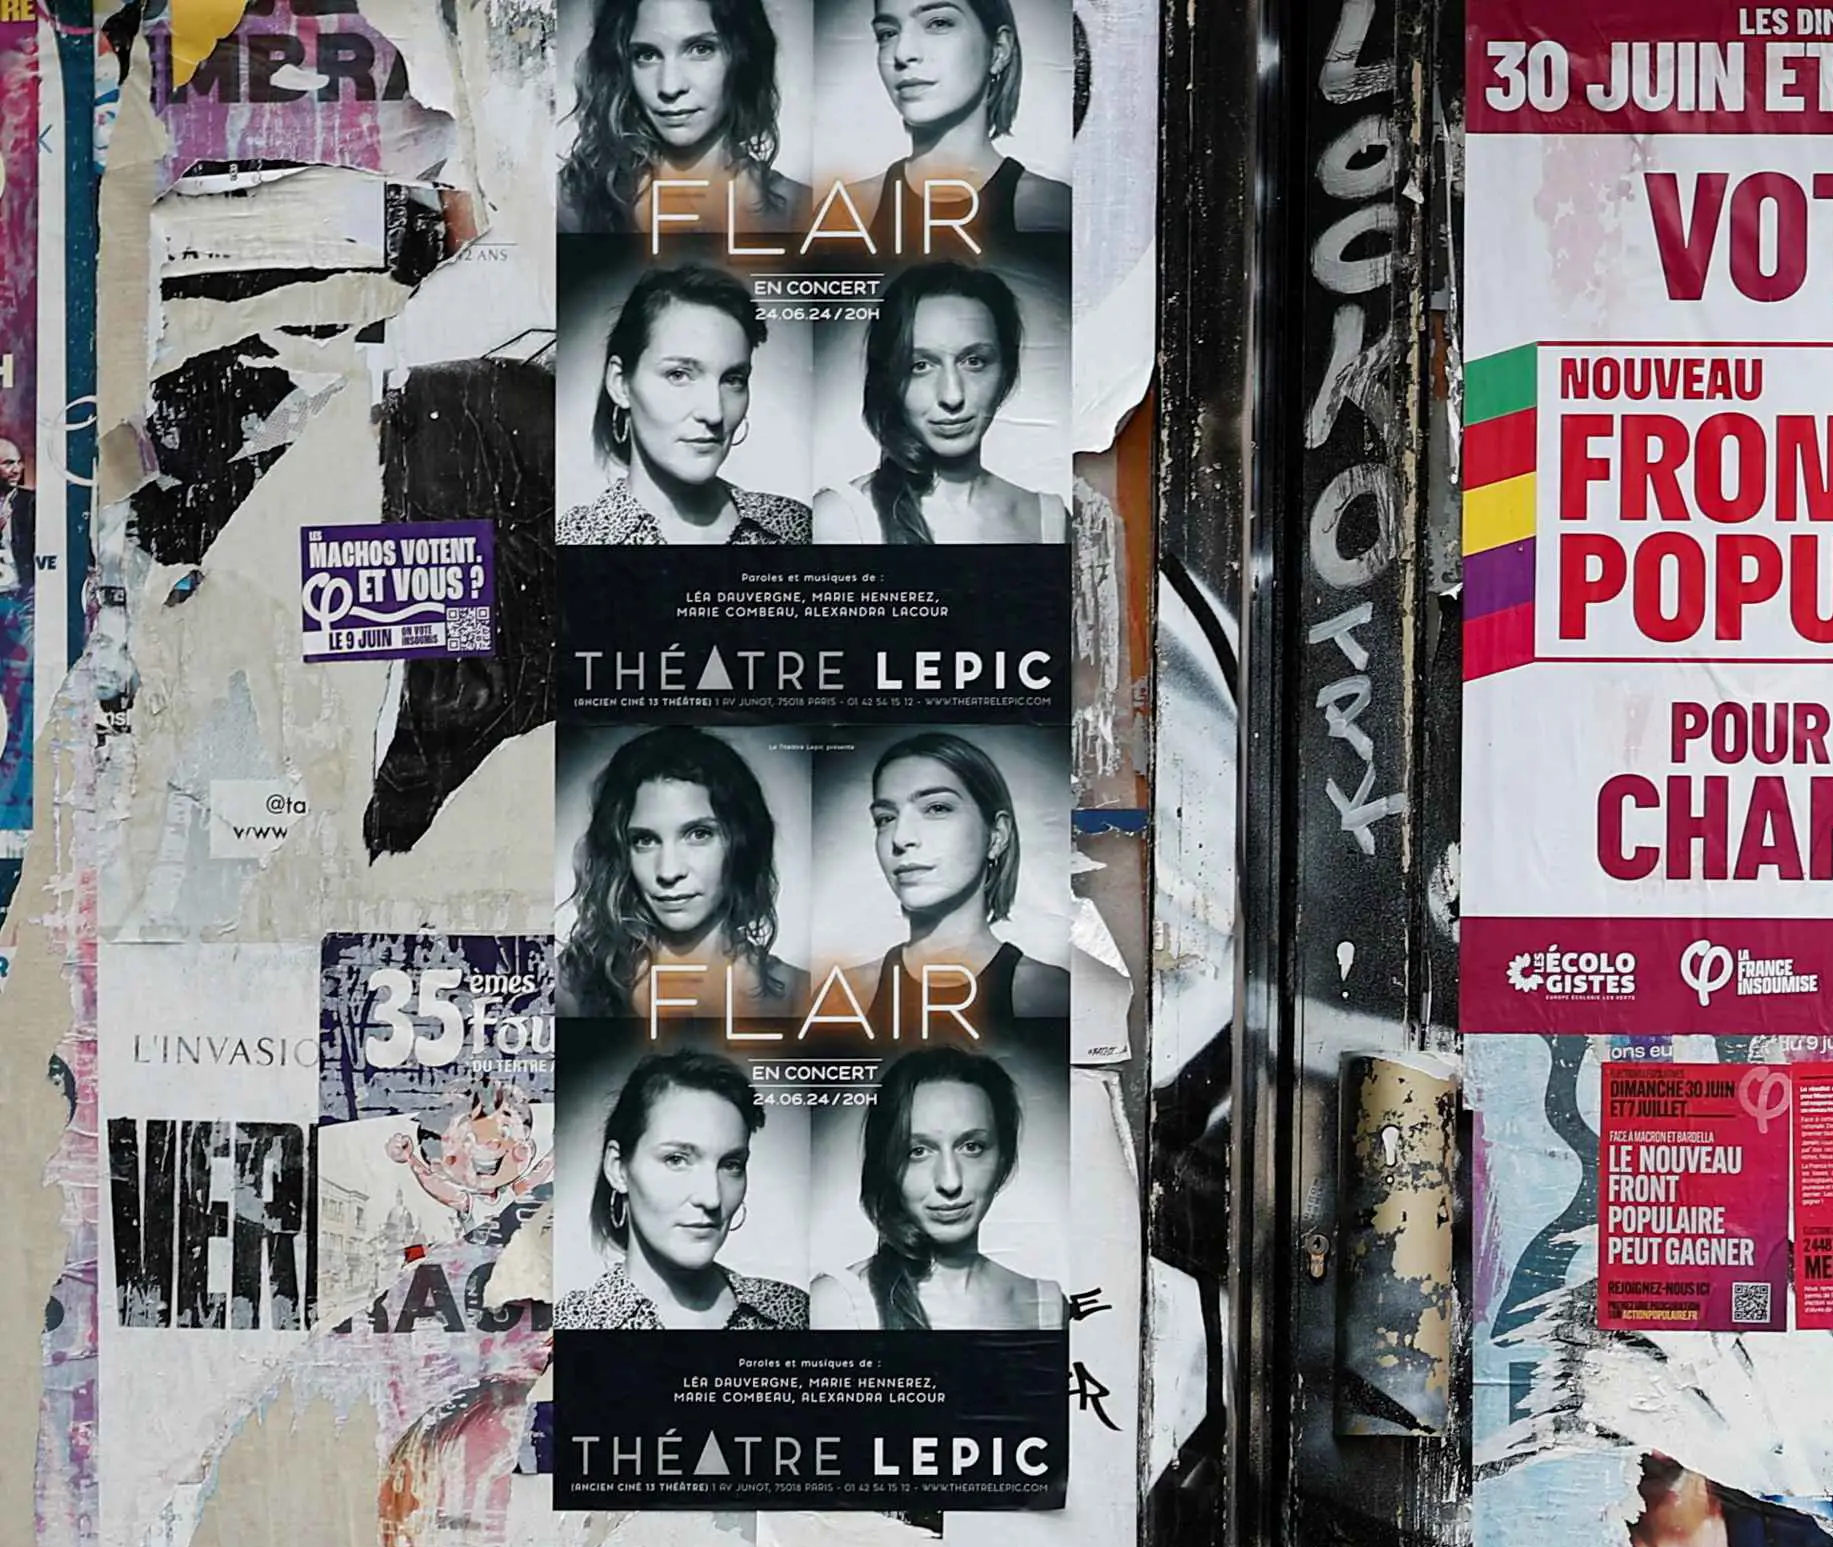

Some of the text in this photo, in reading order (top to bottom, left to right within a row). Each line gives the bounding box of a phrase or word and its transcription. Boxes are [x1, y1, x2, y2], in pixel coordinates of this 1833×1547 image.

[1739, 7, 1792, 36] LES
[1485, 41, 1568, 112] 30
[1586, 41, 1744, 114] JUIN
[652, 179, 982, 255] FLAIR
[754, 281, 880, 295] EN CONCERT
[1560, 357, 1763, 402] NOUVEAU
[309, 531, 322, 541] LES
[309, 537, 482, 568] MACHOS VOTENT.
[358, 566, 463, 603] ET VOUS
[742, 573, 876, 585] Paroles et musiques de
[812, 592, 855, 603] MARIE
[861, 592, 939, 605] HENNEREZ,
[676, 607, 948, 620] MARIE COMBEAU, ALEXANDRA LACOUR
[329, 629, 392, 650] LE 9 JUIN
[877, 651, 1051, 691] LEPIC
[1671, 702, 1829, 766] POUR
[1546, 944, 1636, 973] ÉCOLO
[1738, 950, 1750, 960] LA
[1738, 959, 1793, 977] FRANCE
[1546, 972, 1636, 994] GISTES
[650, 964, 980, 1041] FLAIR
[366, 968, 535, 1068] 35 èmes
[1610, 1081, 1735, 1098] DIMANCHE 30 JUIN
[1611, 1101, 1625, 1117] ET
[1636, 1101, 1686, 1117] JUILLET
[1608, 1146, 1742, 1174] LE NOUVEAU
[1608, 1176, 1679, 1202] FRONT
[1608, 1206, 1725, 1234] POPULAIRE
[1608, 1237, 1754, 1266] PEUT GAGNER
[874, 1437, 1049, 1476] LEPIC
